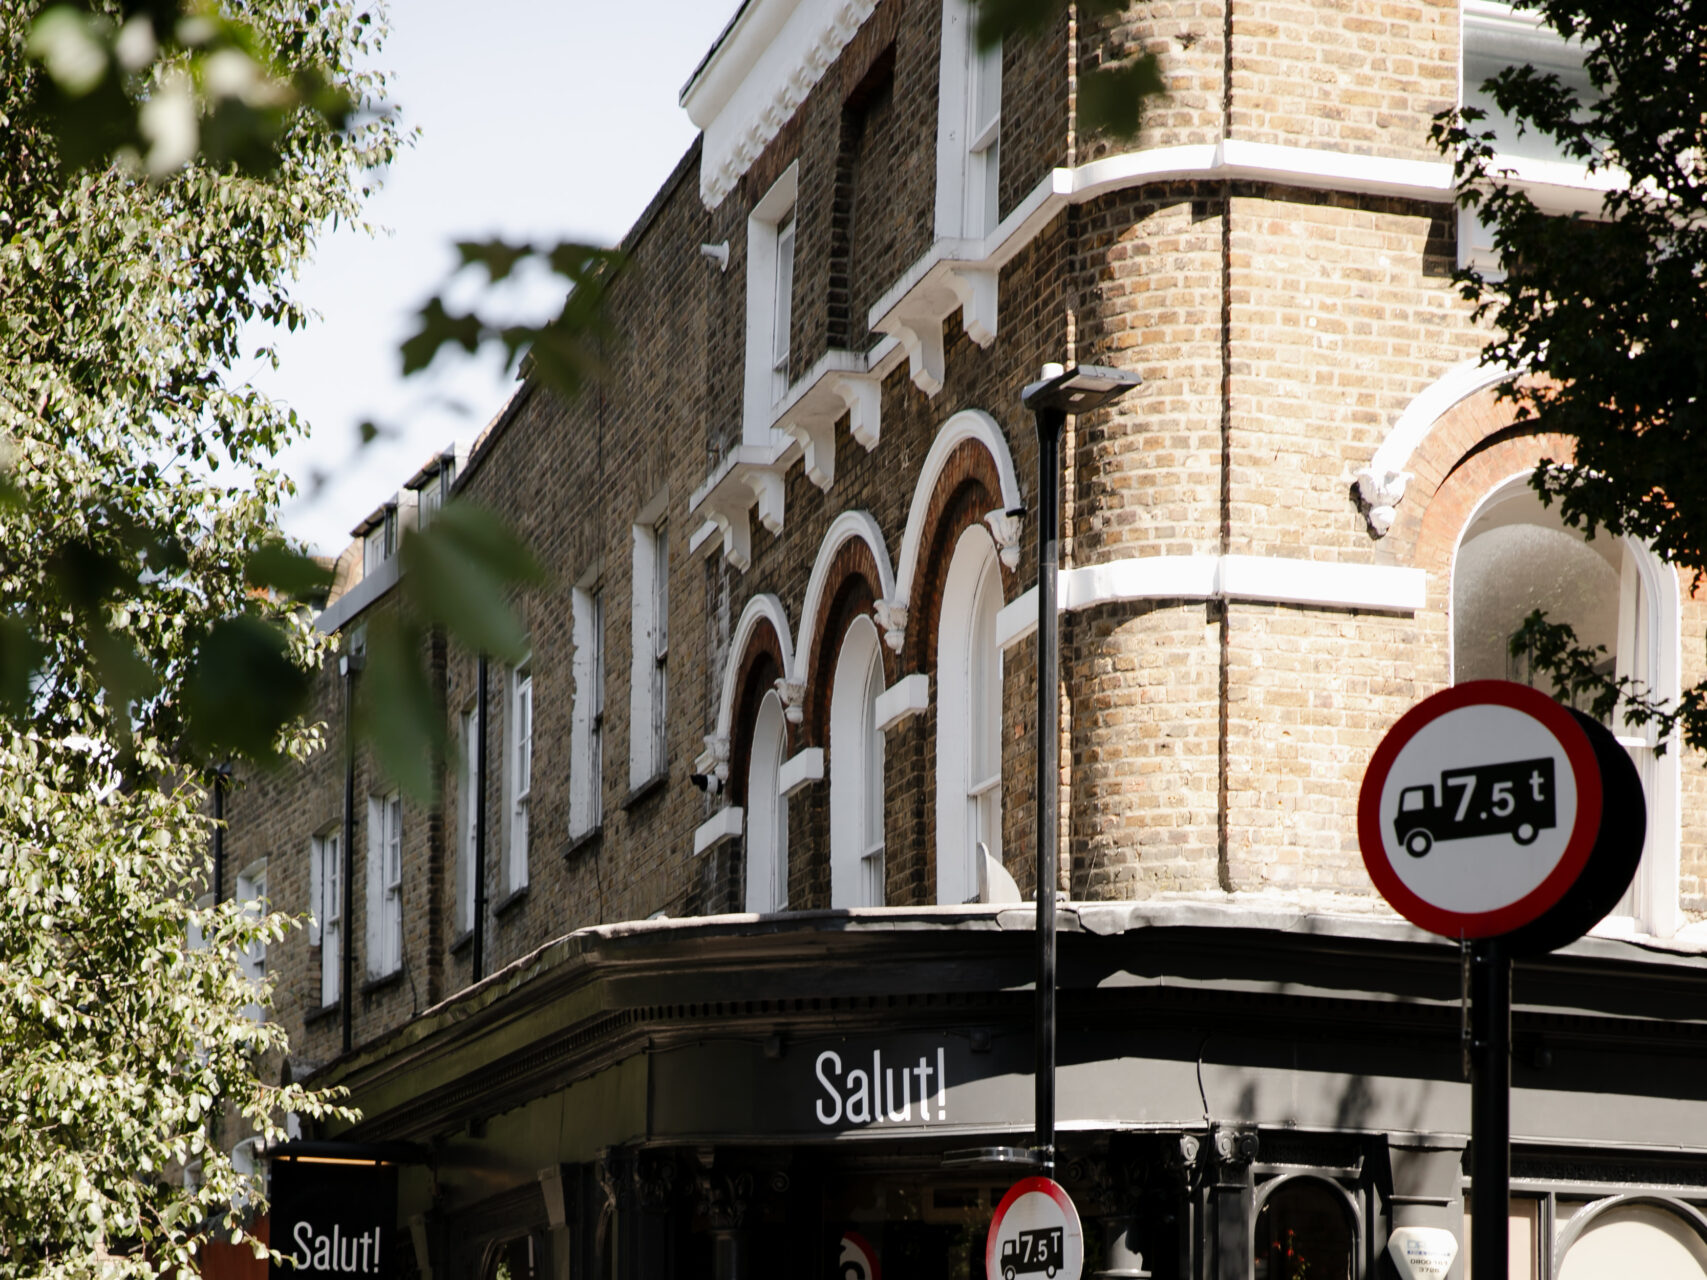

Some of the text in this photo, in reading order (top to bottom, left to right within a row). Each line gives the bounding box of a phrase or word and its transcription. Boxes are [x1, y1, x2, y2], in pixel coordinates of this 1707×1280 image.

[1447, 775, 1515, 822] 7.5
[815, 1046, 946, 1126] Salut!
[292, 1220, 381, 1274] Salut!
